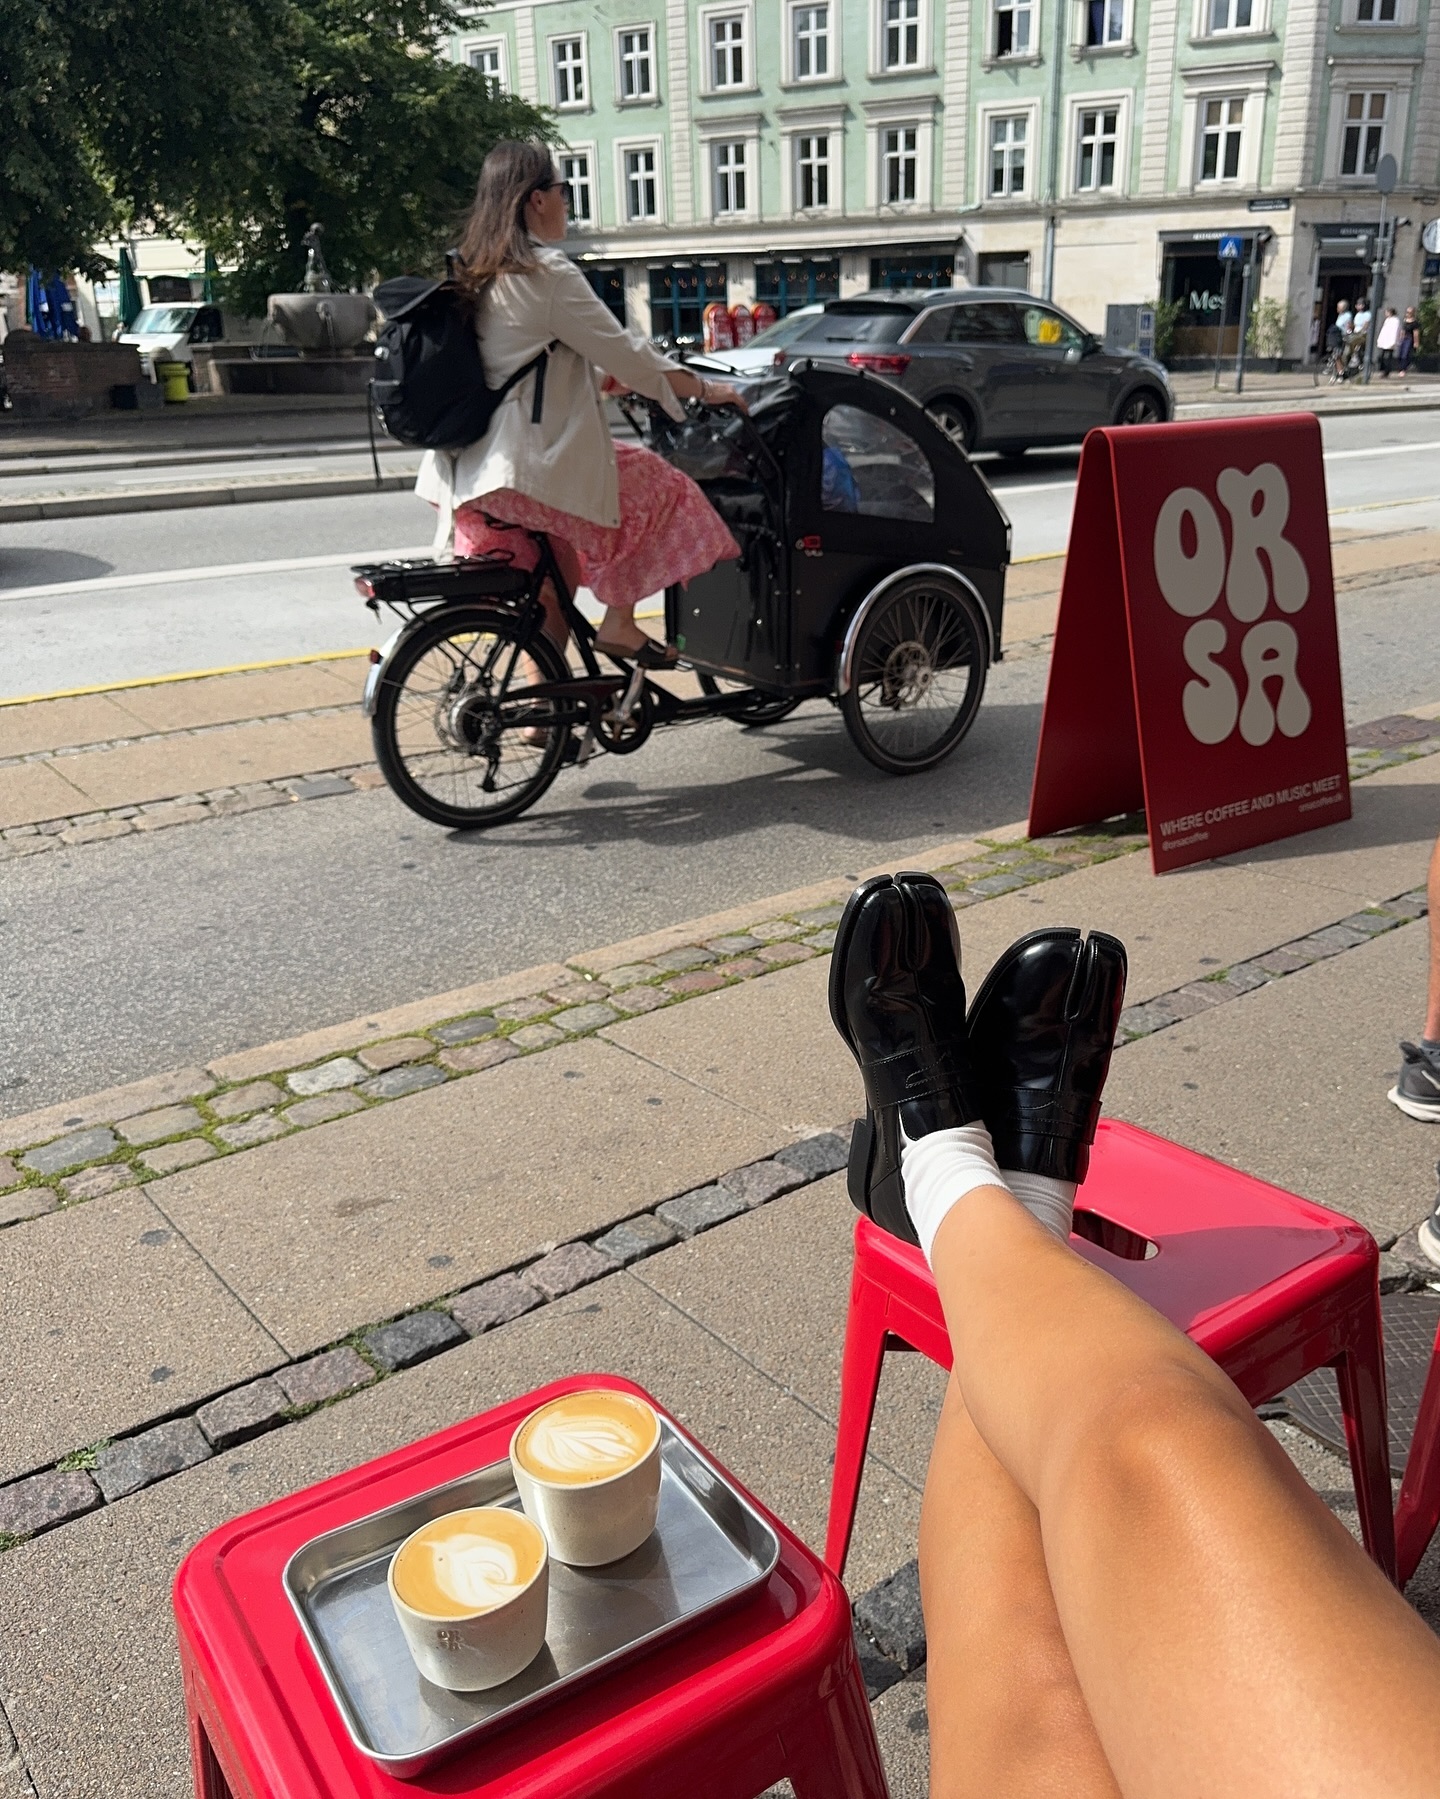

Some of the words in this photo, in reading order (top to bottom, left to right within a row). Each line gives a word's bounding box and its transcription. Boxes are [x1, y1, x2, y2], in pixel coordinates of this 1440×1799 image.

[1154, 463, 1309, 623] OR
[1182, 618, 1312, 747] SA
[1160, 812, 1203, 836] WHERE
[1204, 799, 1250, 824] COFFEE
[1251, 793, 1275, 811] AND
[1276, 783, 1311, 804] MUSIC
[1312, 774, 1341, 794] MEET
[1162, 832, 1208, 851] @orsacoffee
